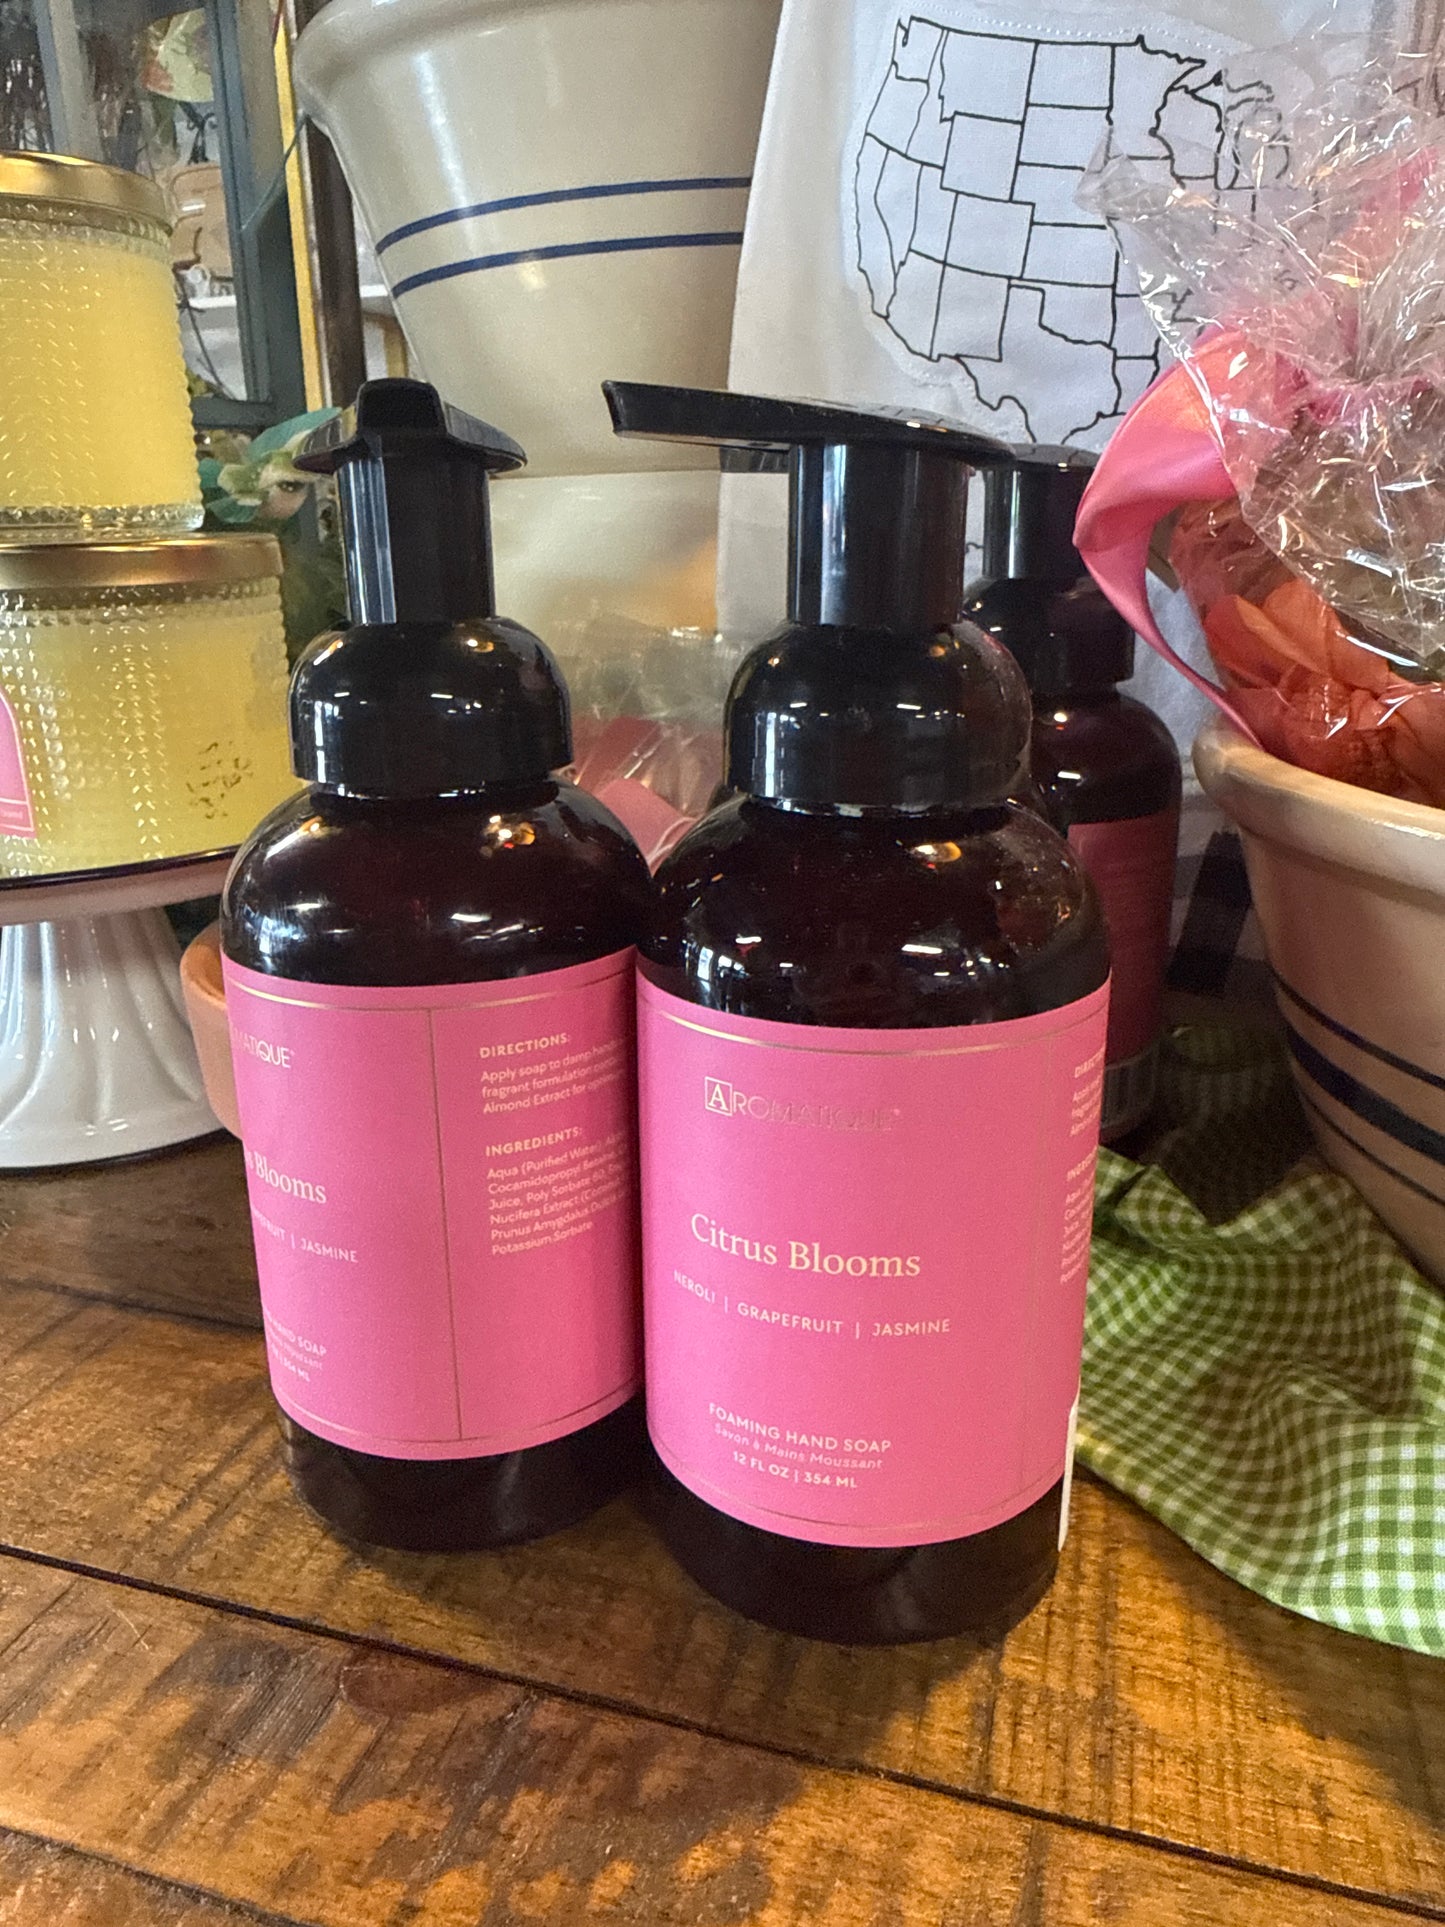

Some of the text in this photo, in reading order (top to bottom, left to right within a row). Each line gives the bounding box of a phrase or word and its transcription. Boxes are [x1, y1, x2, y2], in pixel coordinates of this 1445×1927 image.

[480, 1068, 516, 1083] Apply
[519, 1062, 547, 1076] soap
[549, 1060, 561, 1070] to
[482, 1081, 531, 1100] fragrant
[532, 1065, 593, 1090] formulation
[483, 1082, 587, 1115] Almond Extract for
[484, 1126, 584, 1157] INGREDIENTS:
[254, 1151, 328, 1204] Blooms
[486, 1166, 519, 1182] Aqua
[521, 1152, 568, 1176] (Purified
[526, 1189, 549, 1205] Poly
[551, 1176, 591, 1197] Sorbate
[489, 1208, 541, 1225] Nucifera
[543, 1195, 579, 1214] Extract
[490, 1223, 532, 1241] Prunus
[492, 1220, 594, 1256] Potassium Sorbate
[691, 1213, 921, 1278] Citrus Blooms
[300, 1238, 359, 1263] JASMINE
[673, 1269, 716, 1304] NEROLI
[736, 1302, 844, 1334] GRAPEFRUIT
[872, 1318, 951, 1338] JASMINE
[297, 1335, 327, 1357] SOAP
[708, 1402, 892, 1454] FOAMING HAND SOAP
[715, 1423, 750, 1446] Savon
[764, 1442, 805, 1463] Mains
[809, 1453, 883, 1469] Moussant
[732, 1450, 747, 1466] 12
[751, 1458, 766, 1472] FL
[768, 1463, 790, 1479] OZ
[804, 1471, 831, 1486] 354
[836, 1476, 858, 1489] ML
